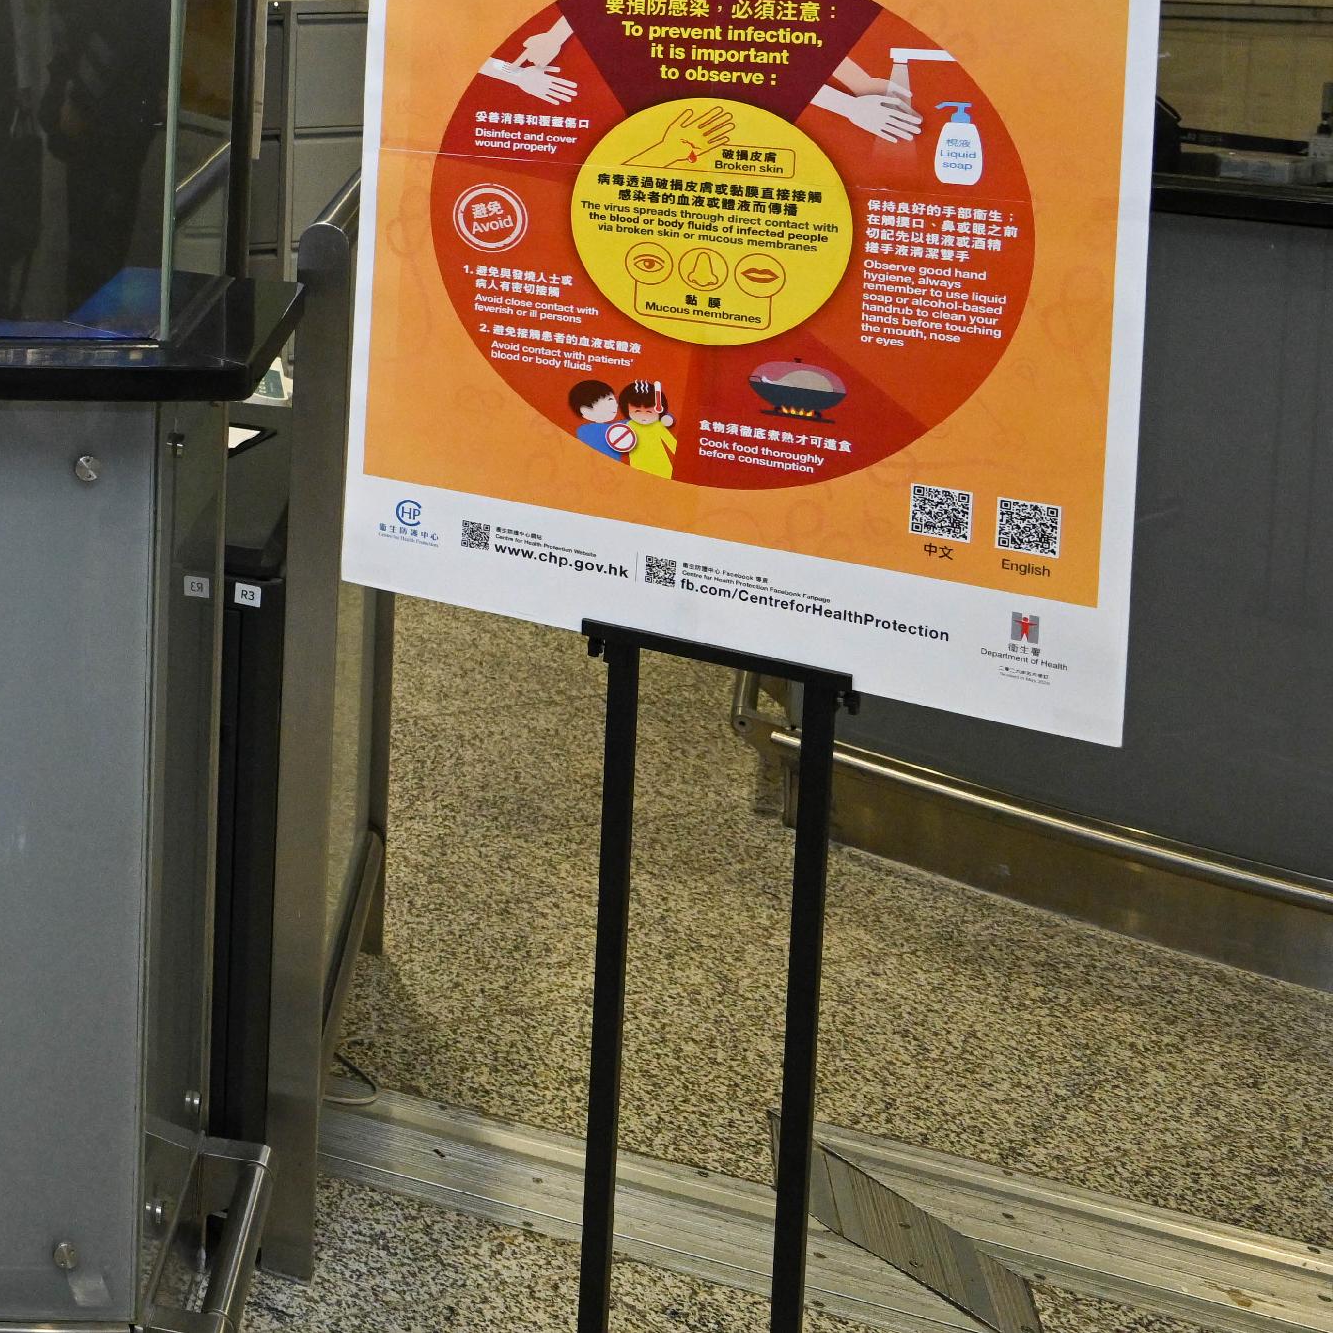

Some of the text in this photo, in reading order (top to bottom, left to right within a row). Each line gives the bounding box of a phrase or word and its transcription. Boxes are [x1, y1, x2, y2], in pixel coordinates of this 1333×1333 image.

[621, 20, 823, 48] To prevent infection,
[650, 42, 790, 65] it is important
[660, 64, 680, 80] to
[685, 66, 765, 85] observe
[475, 127, 577, 144] Disinfect and cover
[475, 138, 557, 155] wound properly
[721, 148, 777, 164] 破損皮膚
[714, 159, 784, 175] Broken skin
[471, 200, 504, 219] 避免
[471, 216, 514, 236] Avoid
[863, 259, 987, 281] Observe good hand
[863, 270, 962, 289] hygiene, always
[698, 447, 814, 474] before consumption
[699, 437, 825, 466] Cook food thoroughly
[494, 542, 629, 579] www.chp.gov.hk
[923, 542, 954, 561] 中文
[1001, 558, 1051, 578] English
[240, 589, 255, 601] R3
[680, 578, 950, 642] fb.com/CentreforHealthProtection
[980, 647, 1068, 672] Department of Health
